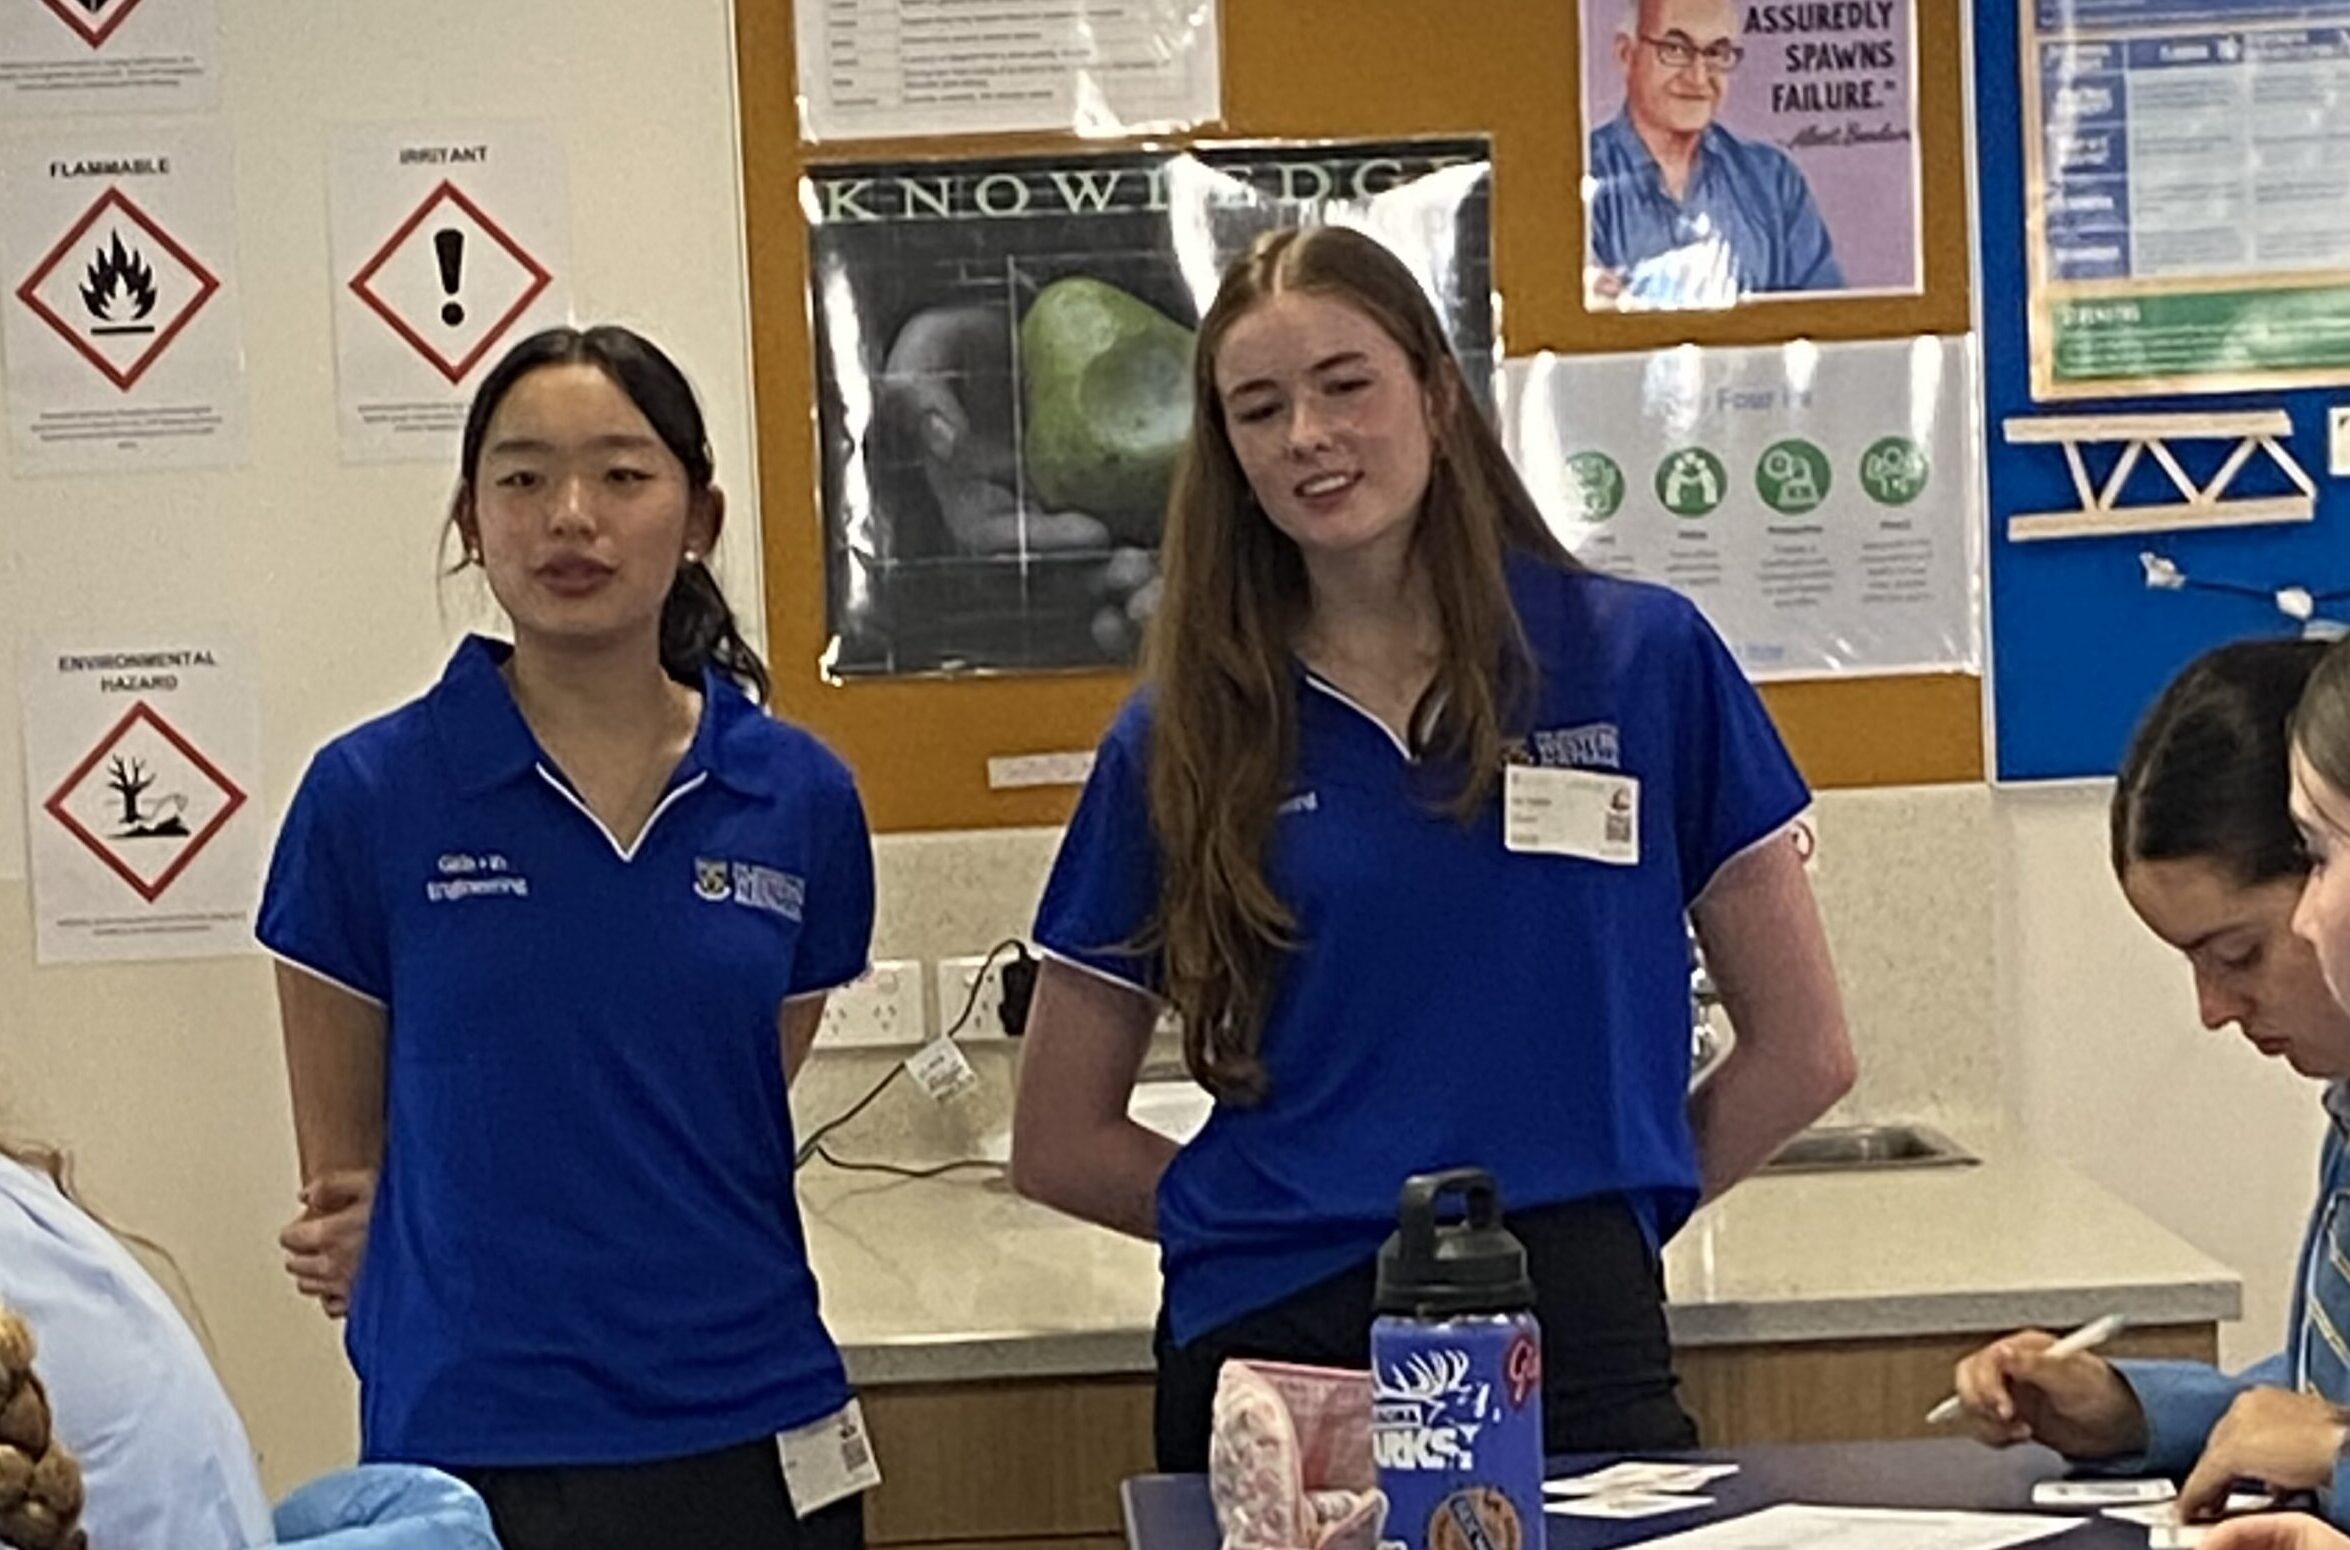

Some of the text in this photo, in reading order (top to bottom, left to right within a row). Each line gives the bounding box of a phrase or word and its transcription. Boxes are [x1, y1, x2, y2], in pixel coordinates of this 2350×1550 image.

[1744, 1, 1893, 33] ASSUREDLY
[1786, 41, 1894, 72] SPAWNS
[1772, 80, 1896, 113] FAILURE."
[400, 146, 487, 165] IRRITANT
[50, 158, 169, 177] FLAMMABLE
[59, 650, 215, 672] ENVIRONMENTAL
[101, 675, 178, 692] HAZARD
